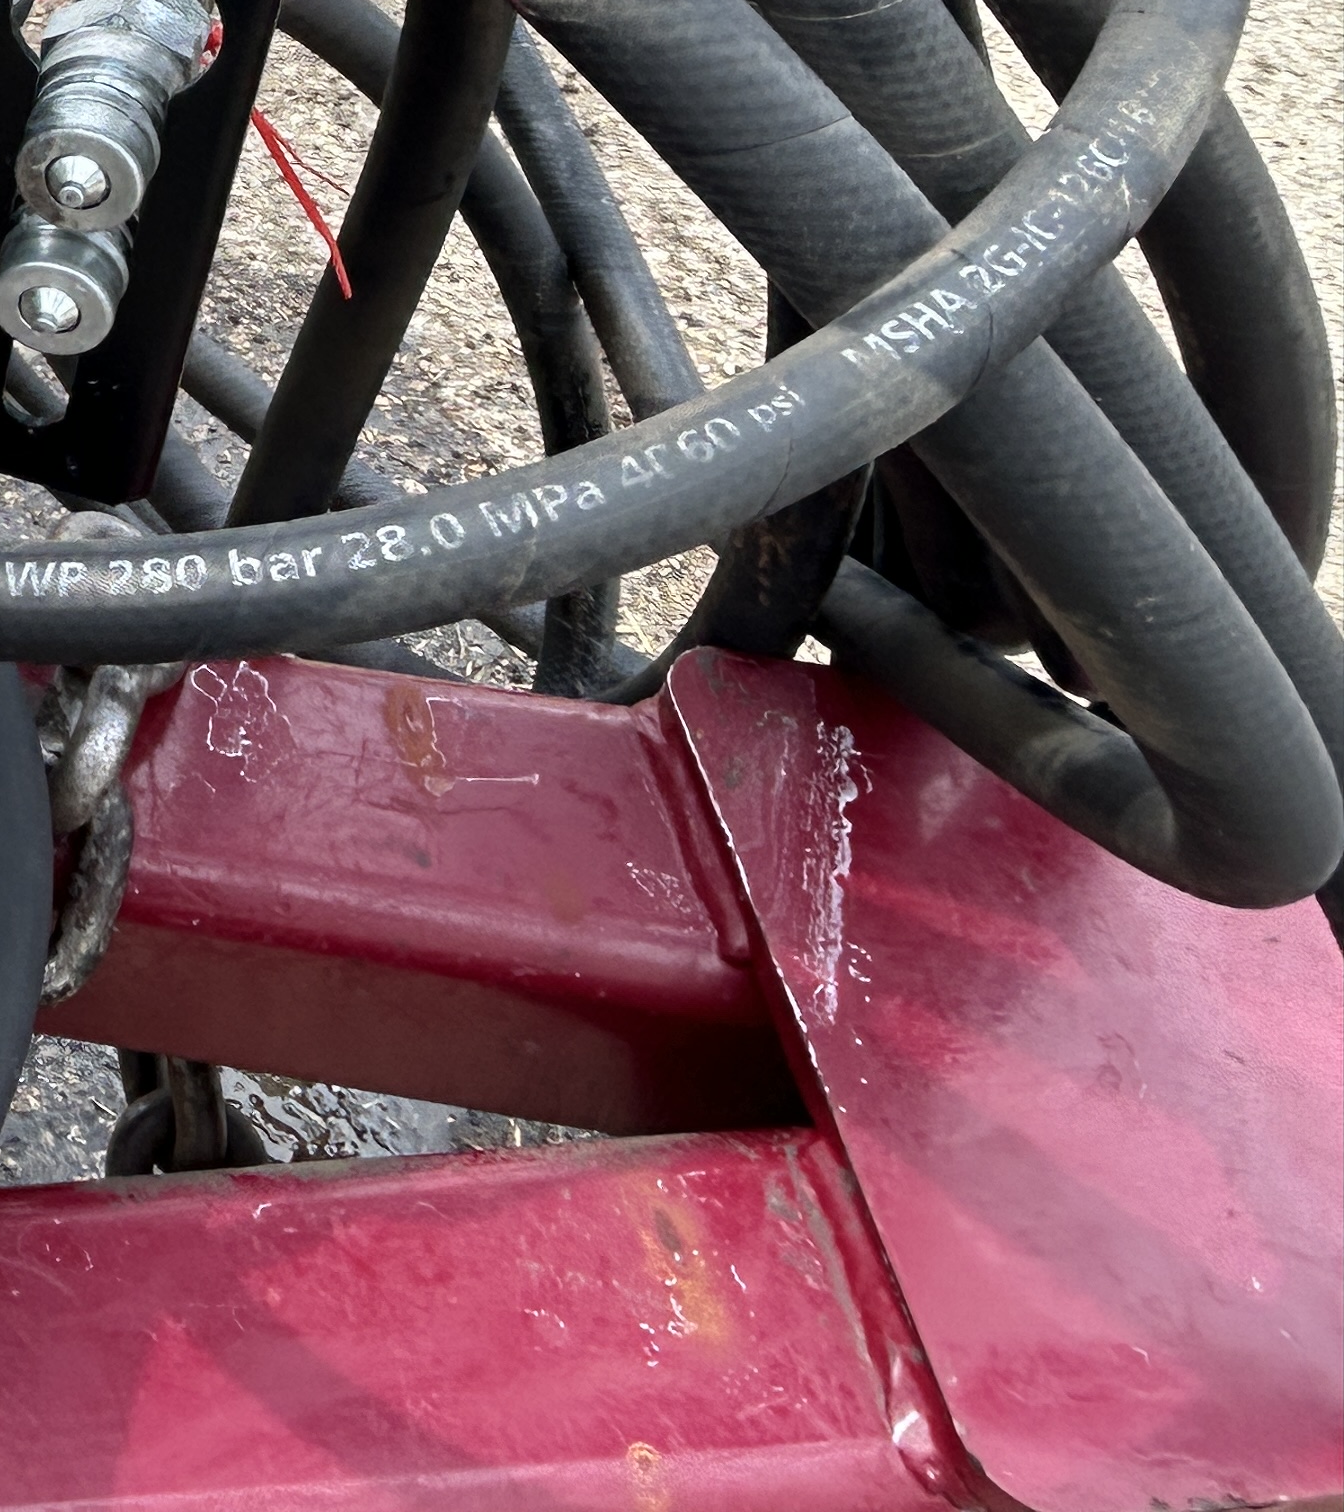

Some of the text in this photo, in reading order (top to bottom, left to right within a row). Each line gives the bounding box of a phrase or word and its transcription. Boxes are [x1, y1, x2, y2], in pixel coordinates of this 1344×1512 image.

[4, 559, 87, 599] WP
[108, 553, 209, 597] 280
[227, 545, 323, 587] bar
[339, 511, 467, 572] 28.0
[477, 478, 609, 539] MPa
[746, 384, 806, 432] psi
[839, 287, 978, 367] MSHA
